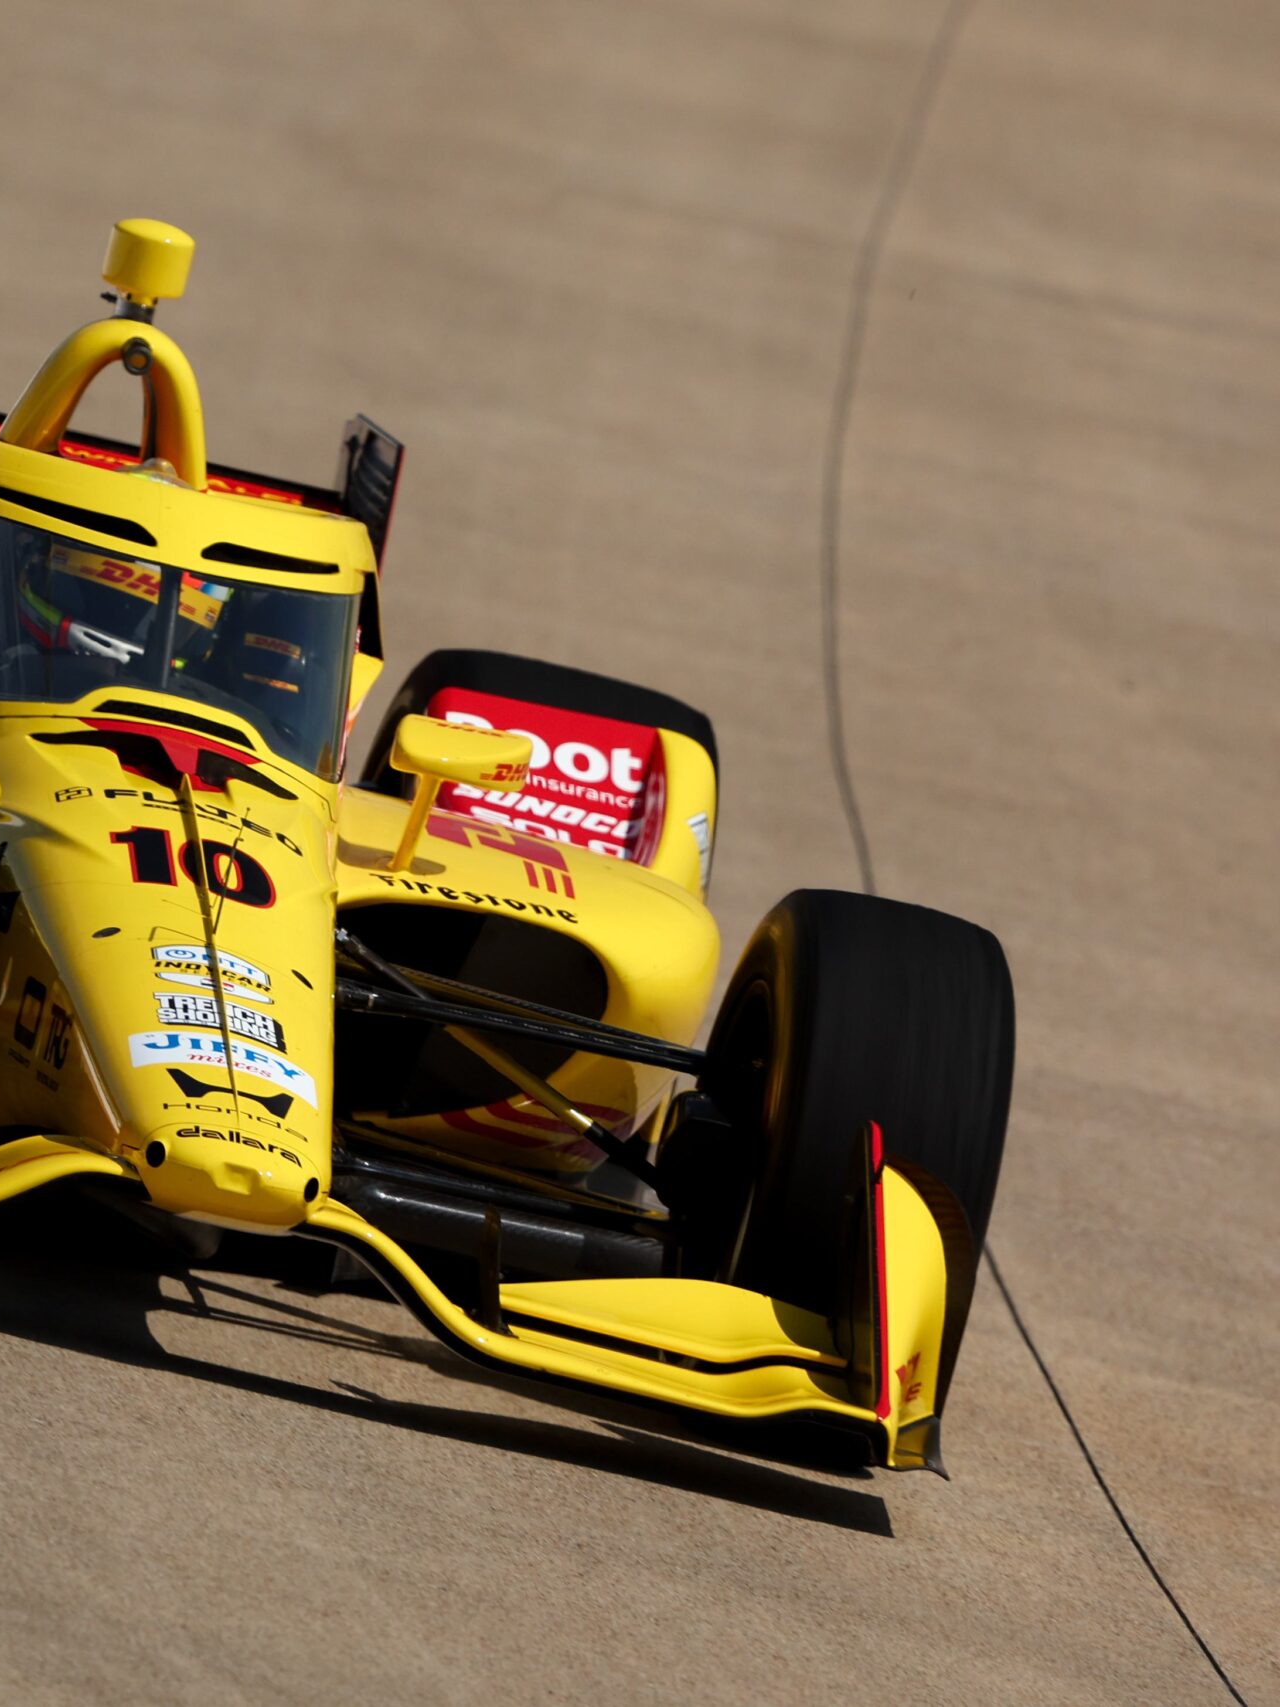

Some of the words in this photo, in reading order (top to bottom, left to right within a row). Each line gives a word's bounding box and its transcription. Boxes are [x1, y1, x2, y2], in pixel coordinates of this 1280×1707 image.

[94, 560, 160, 597] DH
[487, 763, 529, 782] DH
[452, 783, 642, 839] SUNOCO
[109, 825, 277, 909] 10
[369, 873, 579, 924] Firestone
[154, 961, 271, 993] INDYCAR
[179, 968, 247, 987] SERES
[154, 994, 276, 1033] TRENCH
[158, 1008, 278, 1042] SHORING
[142, 1033, 302, 1080] JIFFY
[176, 1125, 302, 1168] dallara
